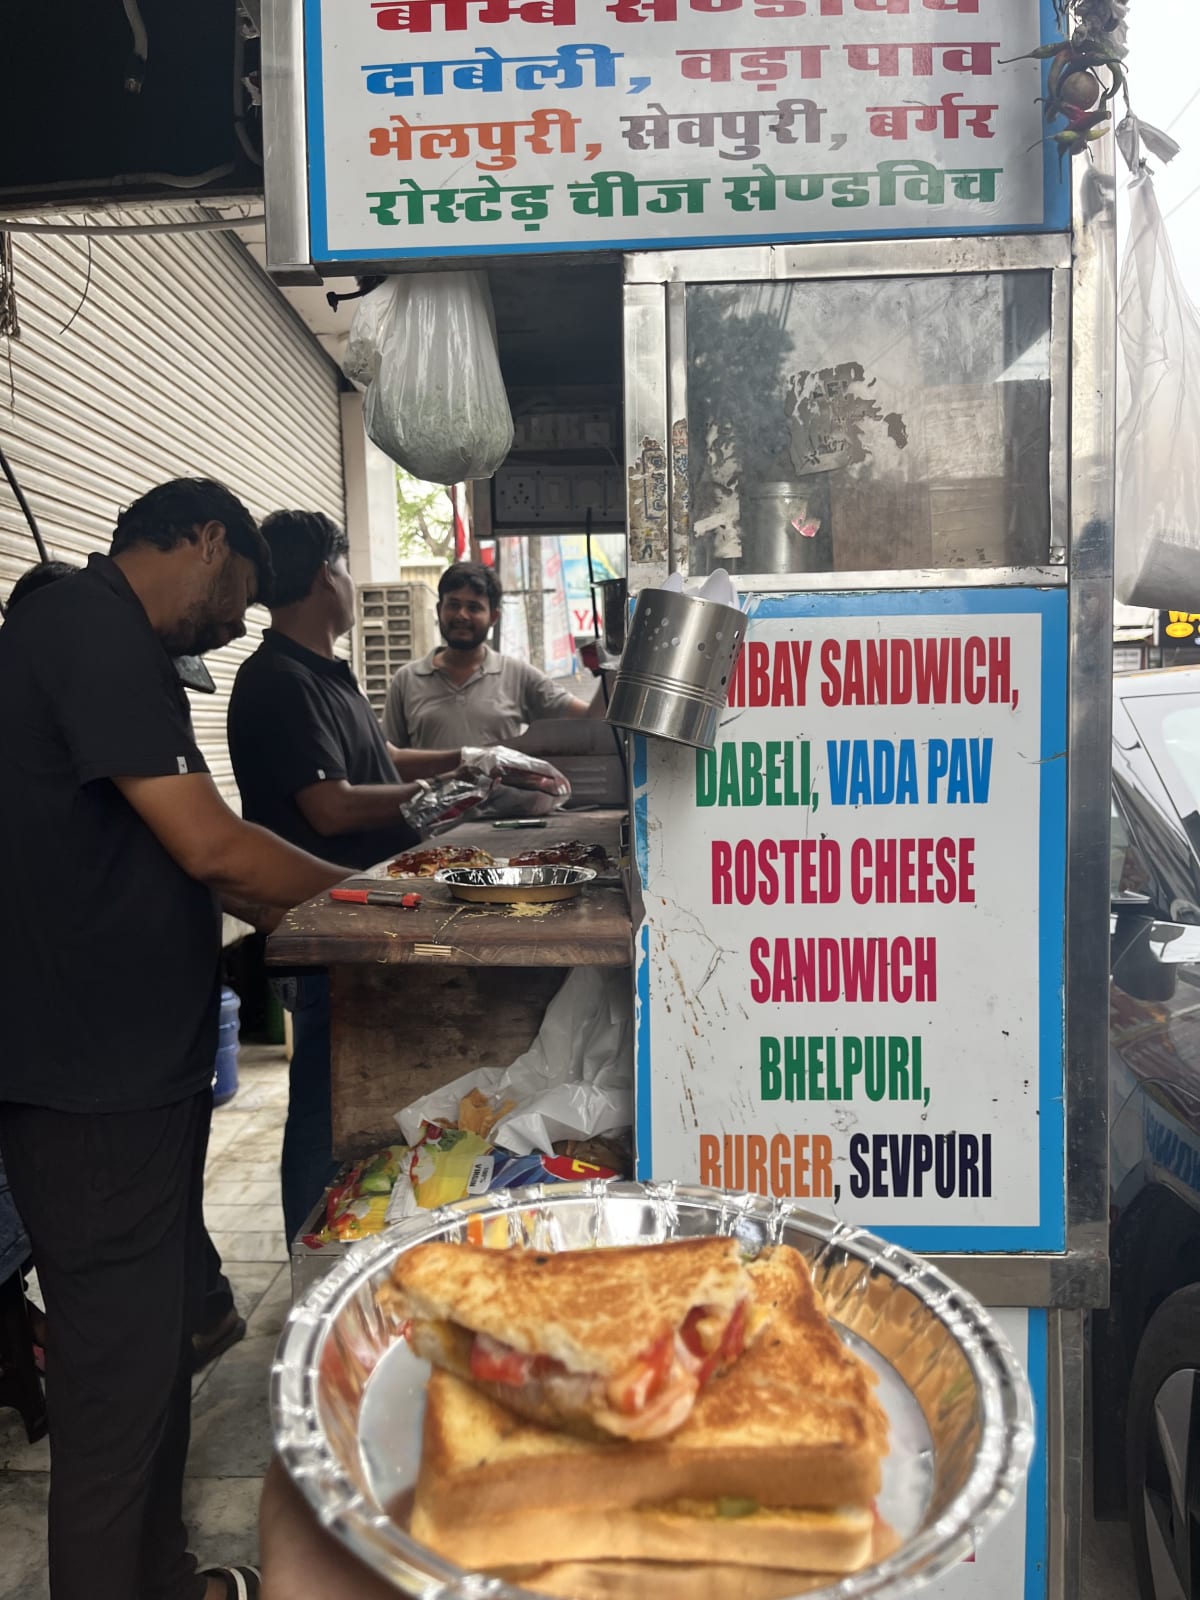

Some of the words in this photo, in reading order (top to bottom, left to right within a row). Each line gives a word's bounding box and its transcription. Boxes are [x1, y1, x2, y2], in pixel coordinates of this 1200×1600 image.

[361, 44, 651, 97] दाबेली,
[675, 45, 829, 91] वड़ा
[843, 42, 1001, 77] पाव
[369, 108, 602, 171] भेलपुरी,
[619, 98, 848, 160] सेवपुरी,
[866, 94, 998, 139] बर्गर
[366, 175, 554, 232] रोस्टेड़
[567, 171, 711, 217] चीज
[722, 159, 1003, 212] सेण्डविच
[820, 636, 1019, 711] SANDWICH,
[696, 740, 819, 813] DABELI,
[827, 739, 919, 806] VADA
[928, 738, 993, 804] PAV
[711, 839, 840, 906] ROSTED
[851, 837, 976, 905] CHEESE
[750, 936, 937, 1003] SANDWICH
[760, 1036, 931, 1107] BHELPURI,
[849, 1133, 992, 1199] SEVPURI
